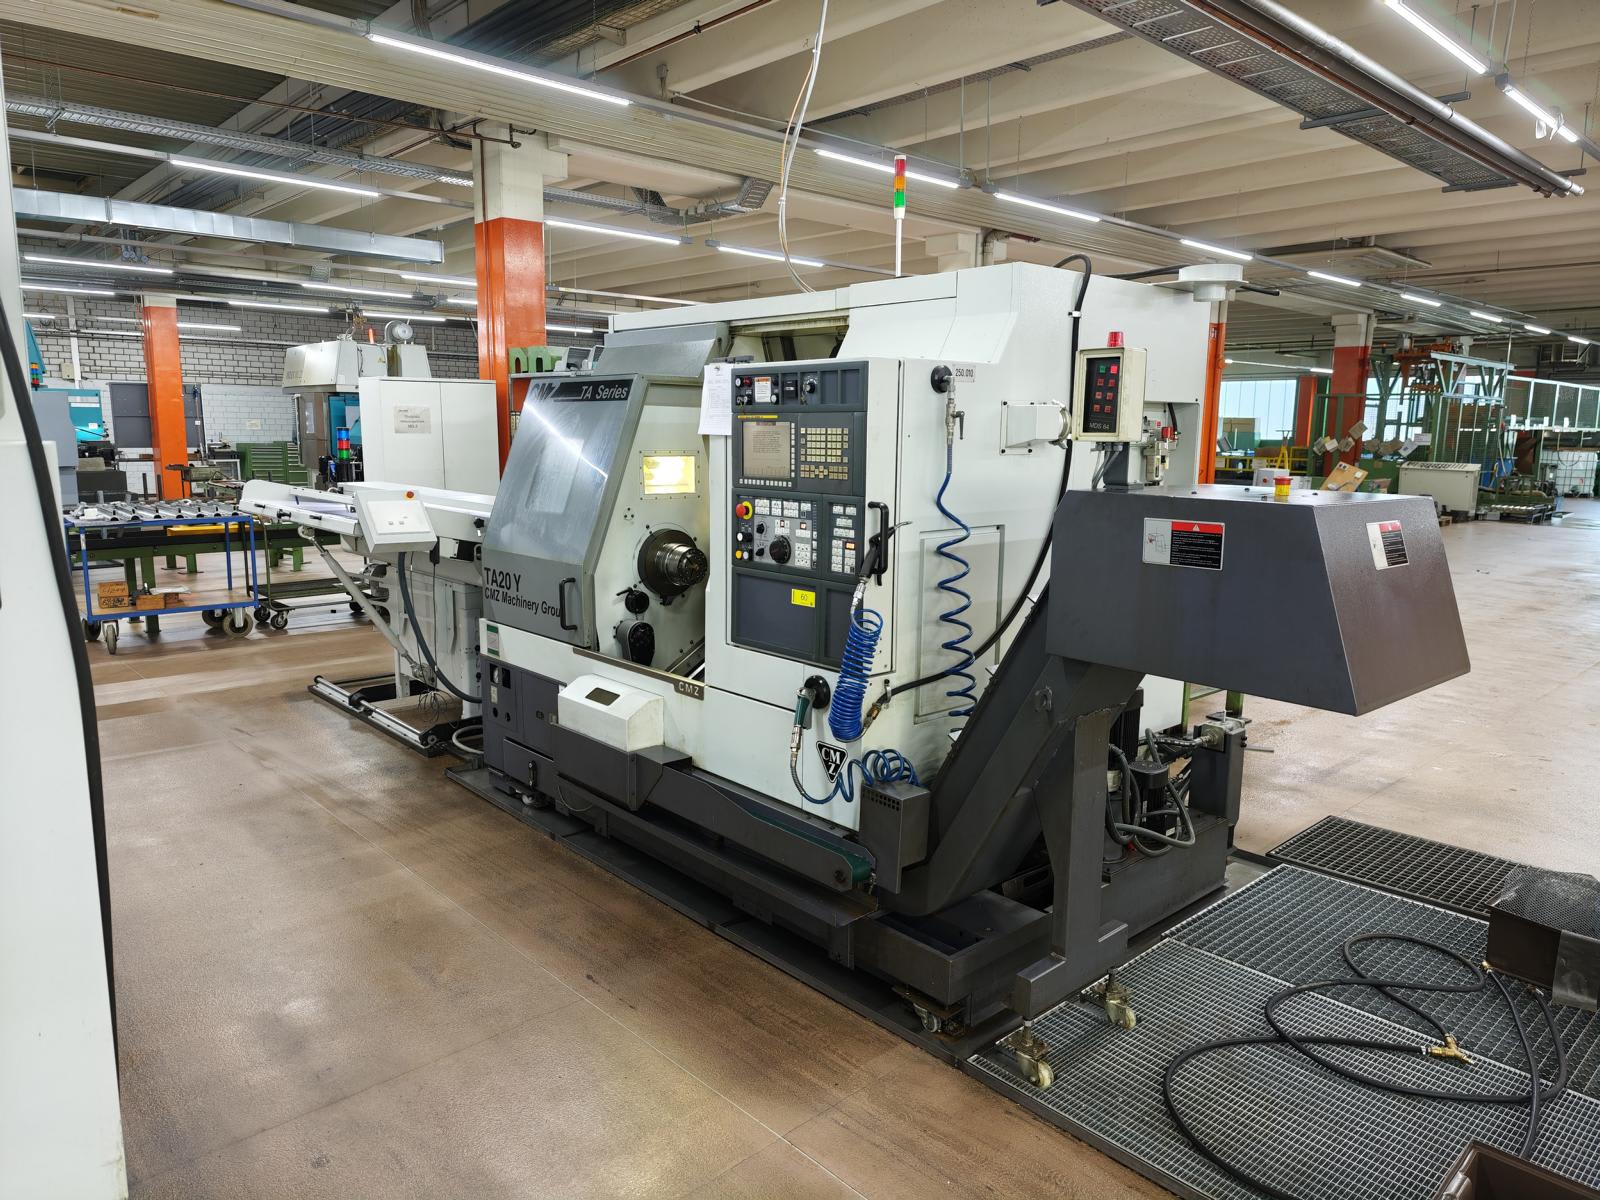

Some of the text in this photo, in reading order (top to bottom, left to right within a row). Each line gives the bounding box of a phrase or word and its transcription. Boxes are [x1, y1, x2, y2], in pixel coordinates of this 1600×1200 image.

[955, 368, 974, 377] 250.010
[580, 386, 592, 399] TA
[596, 385, 628, 399] Series
[484, 567, 521, 592] TA20 Y
[484, 587, 561, 617] CMZ Machinery Grou
[678, 681, 699, 696] CMZ
